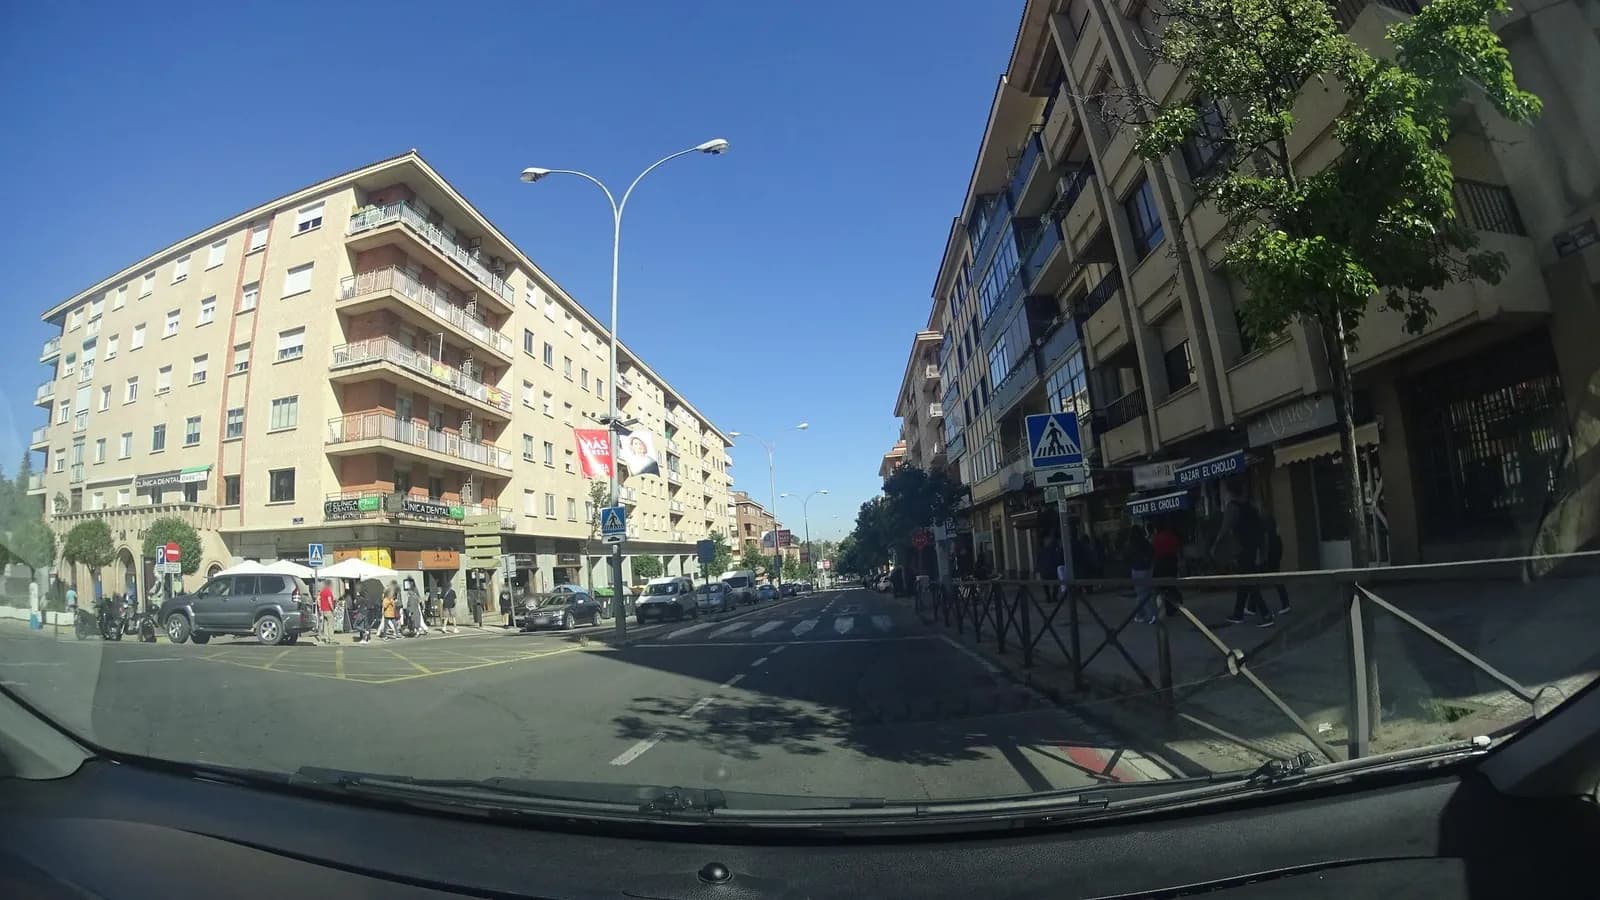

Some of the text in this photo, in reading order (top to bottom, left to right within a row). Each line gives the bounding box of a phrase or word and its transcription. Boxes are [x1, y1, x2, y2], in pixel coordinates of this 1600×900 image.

[1180, 469, 1200, 483] BAZAR
[1202, 466, 1210, 477] EL
[1211, 458, 1237, 474] CHOLLO
[157, 476, 181, 485] DENTAL
[332, 505, 358, 513] DENTAL
[426, 505, 450, 516] DENTAL
[1132, 497, 1180, 514] BAZAR EL CHOLLO
[158, 548, 164, 563] P
